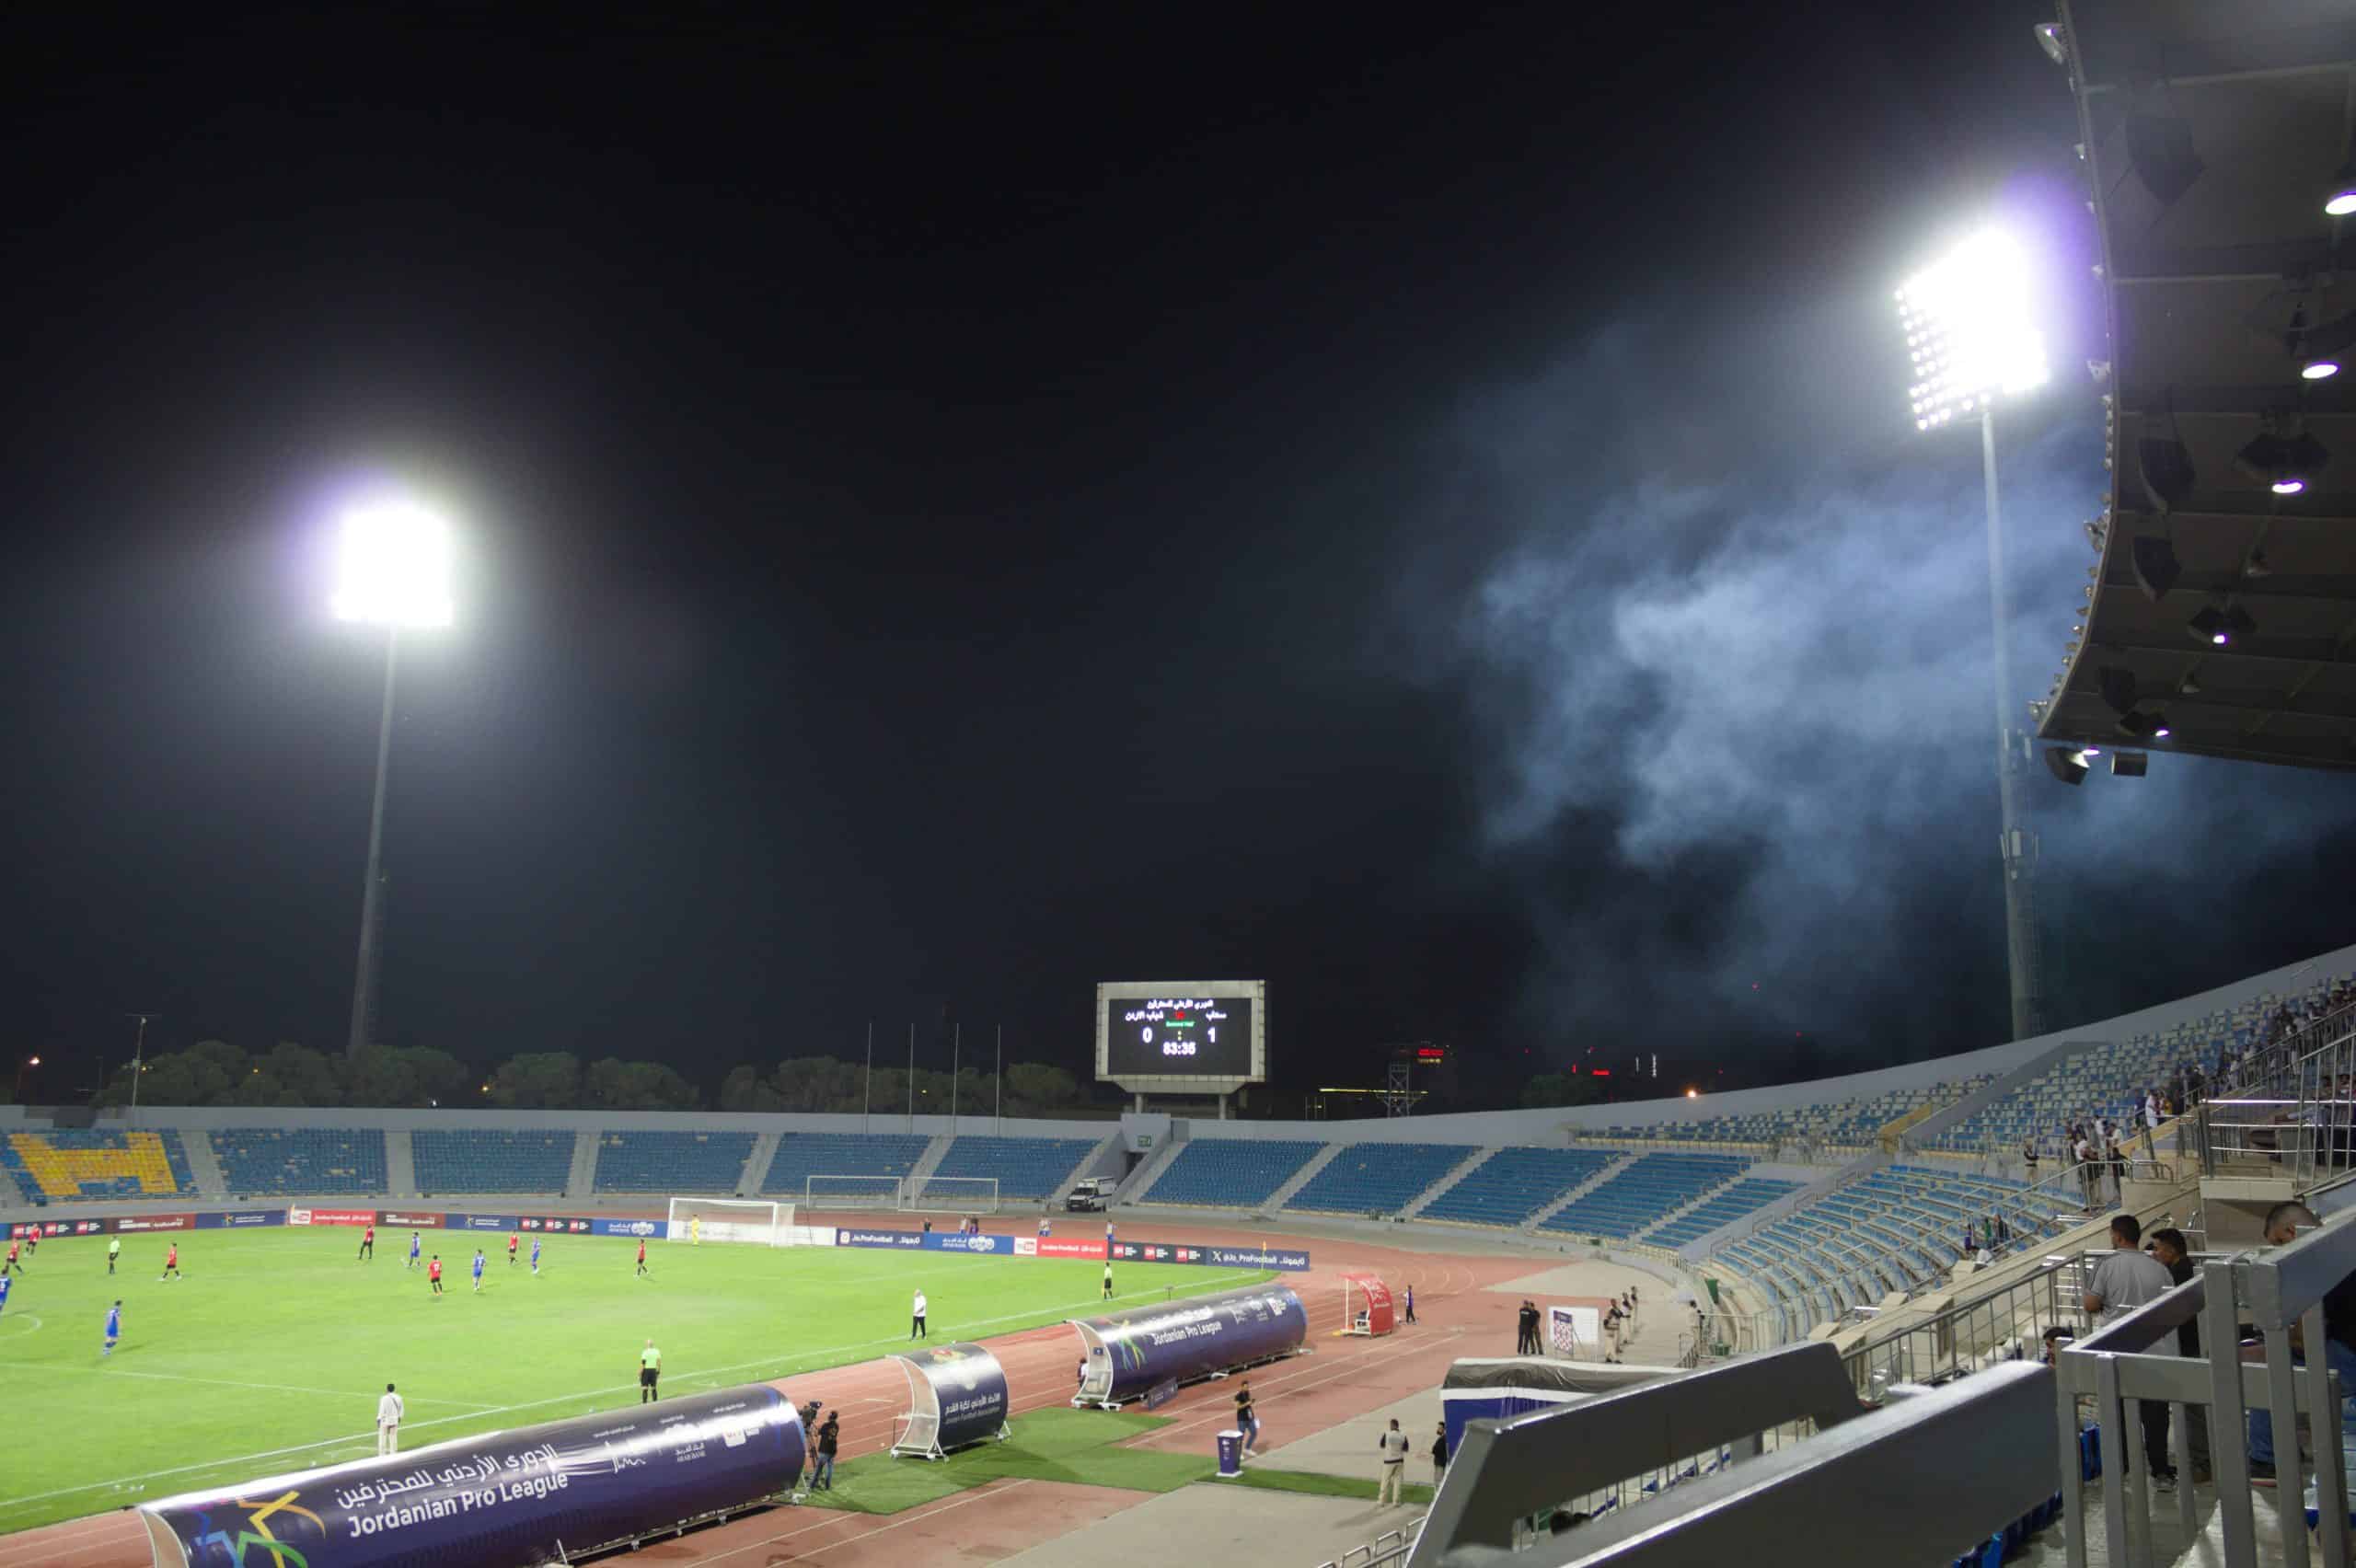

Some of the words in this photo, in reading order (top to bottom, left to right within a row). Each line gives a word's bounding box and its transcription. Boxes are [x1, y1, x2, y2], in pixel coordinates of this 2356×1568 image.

[1142, 1027, 1152, 1043] 0
[1207, 1027, 1216, 1043] 1
[1149, 1328, 1186, 1346] Jordanian
[1185, 1325, 1198, 1338] Pro
[1198, 1320, 1222, 1335] League
[436, 1454, 501, 1488] الأردني
[505, 1443, 559, 1472] الدوري
[336, 1470, 434, 1510] للمحترفين
[348, 1496, 457, 1539] Jordanian
[461, 1486, 496, 1513] Pro
[501, 1472, 569, 1504] League
